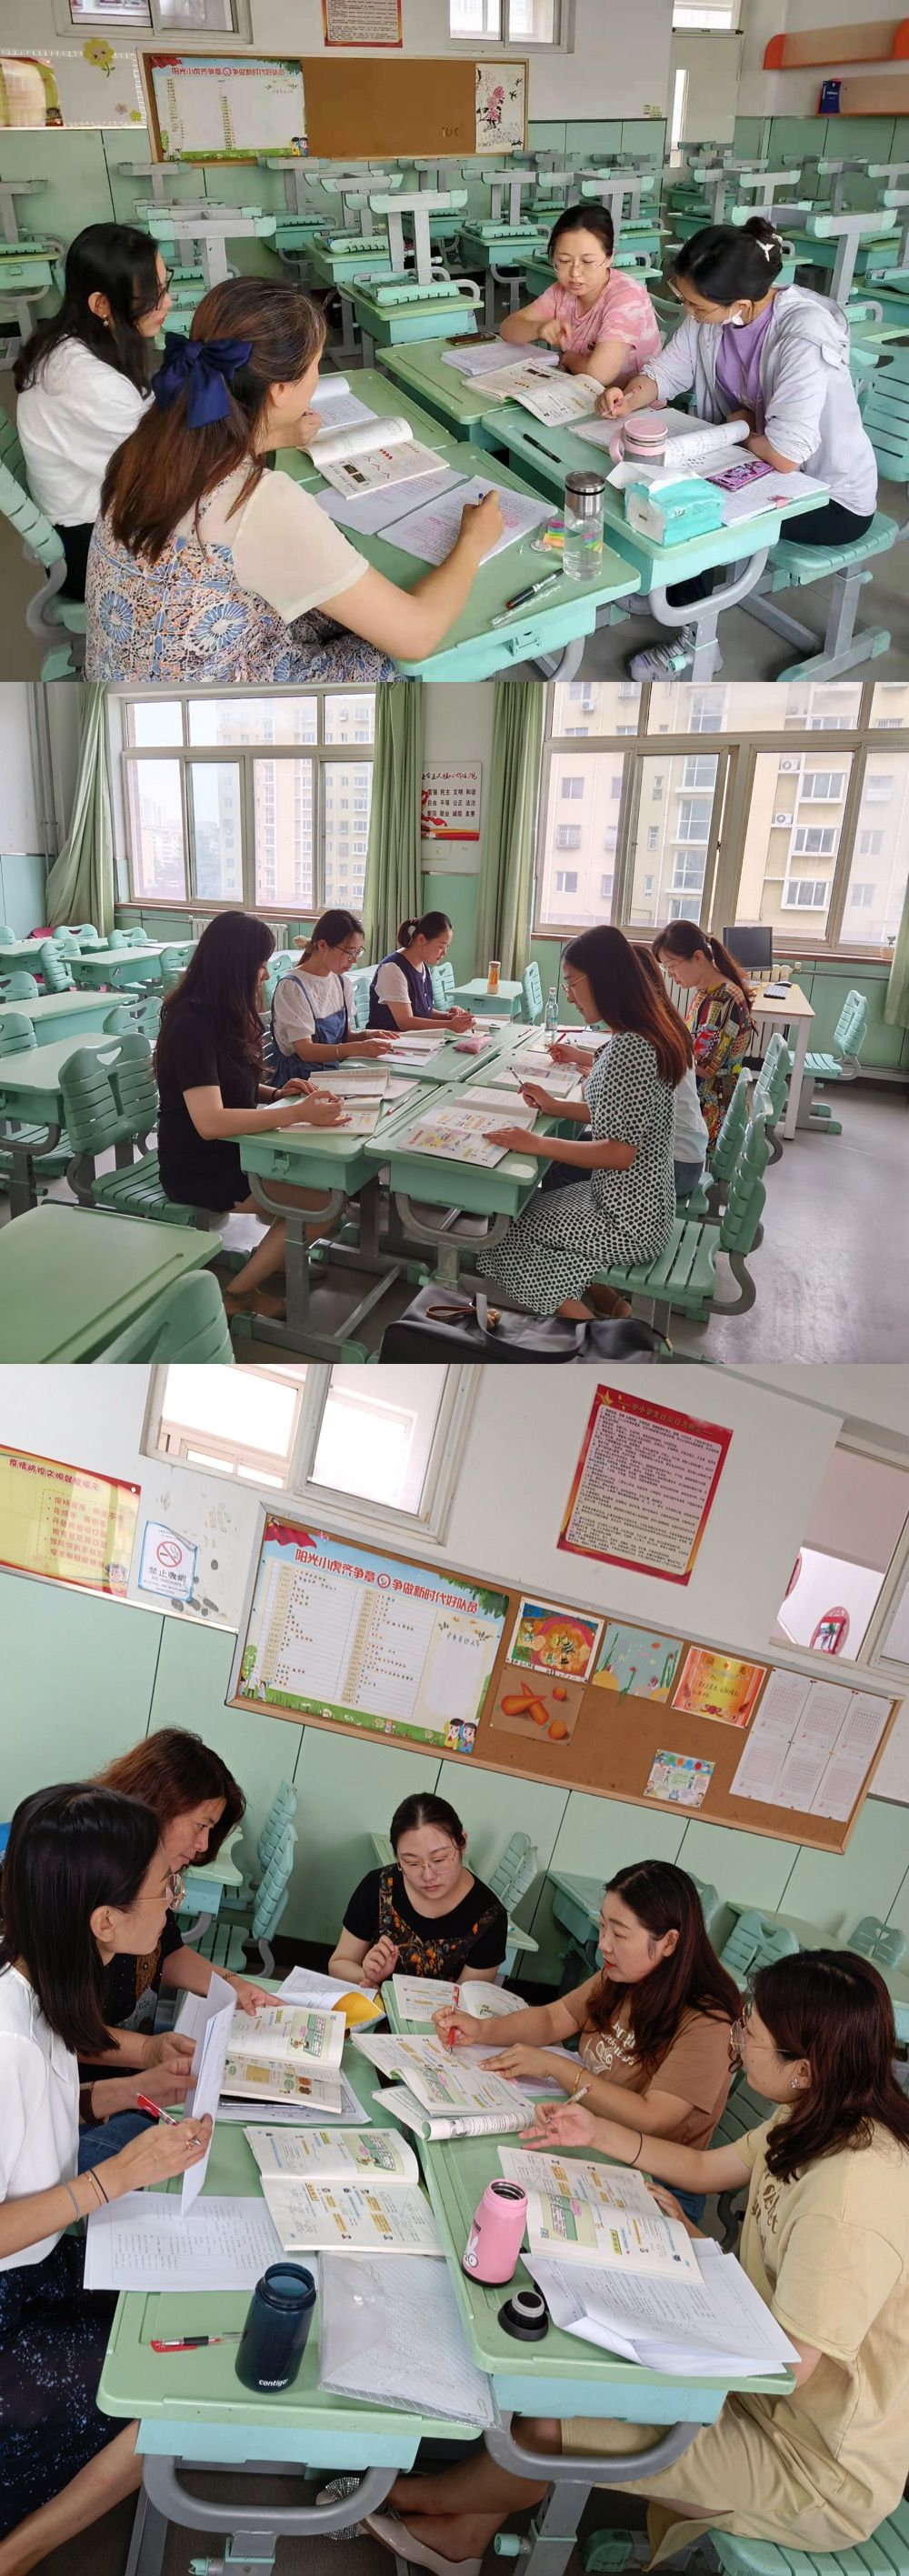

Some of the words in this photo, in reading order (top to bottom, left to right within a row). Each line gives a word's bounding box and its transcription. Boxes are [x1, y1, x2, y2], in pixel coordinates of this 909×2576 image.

[148, 1567, 187, 1583] 禁止吸烟
[295, 1548, 376, 1584] 阳光小虎齐争章
[392, 1578, 479, 1615] 争做新时代好队员
[258, 2379, 289, 2388] contigo
